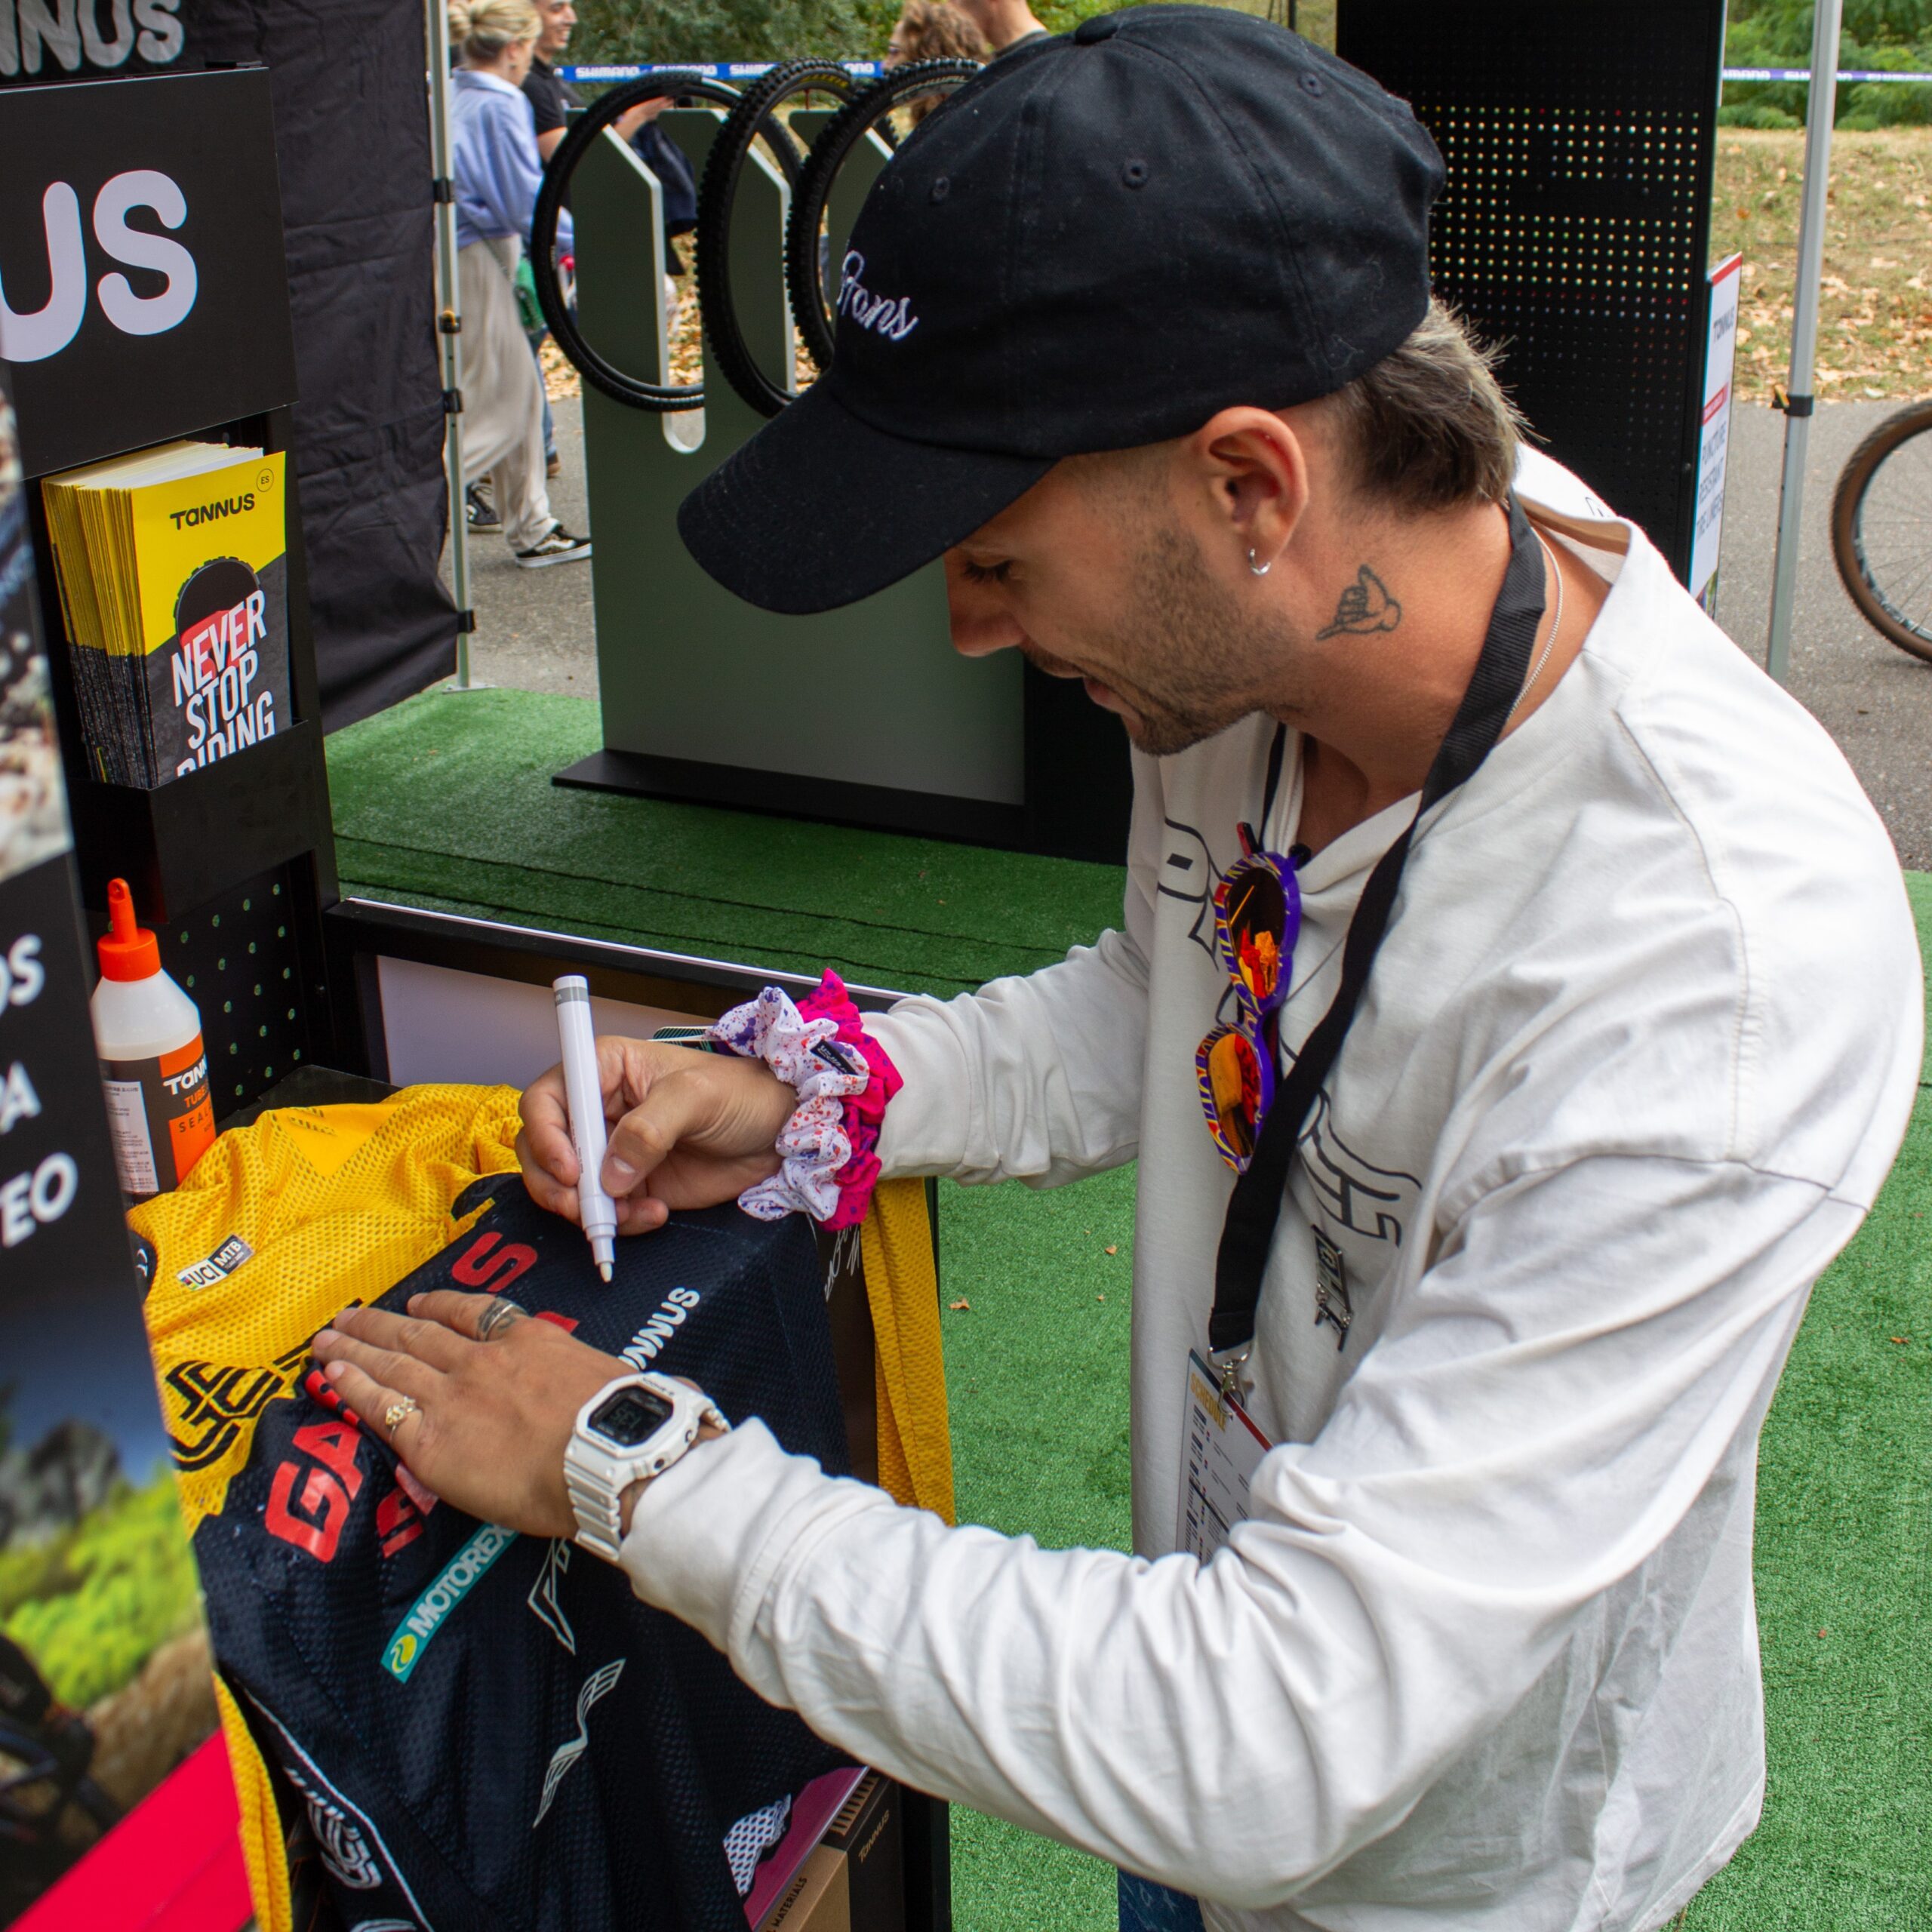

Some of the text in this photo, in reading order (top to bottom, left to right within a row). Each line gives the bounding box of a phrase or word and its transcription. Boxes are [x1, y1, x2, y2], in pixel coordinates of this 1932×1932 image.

[260, 475, 269, 485] ES
[171, 589, 266, 707] NEVER
[177, 691, 275, 779] ING
[186, 649, 258, 749] STOP
[188, 1263, 221, 1285] UCI
[214, 1240, 242, 1267] MTB
[618, 1286, 700, 1371] NNUS
[406, 1524, 516, 1638] MOTOREX
[771, 1876, 808, 1927] MATERIALS
